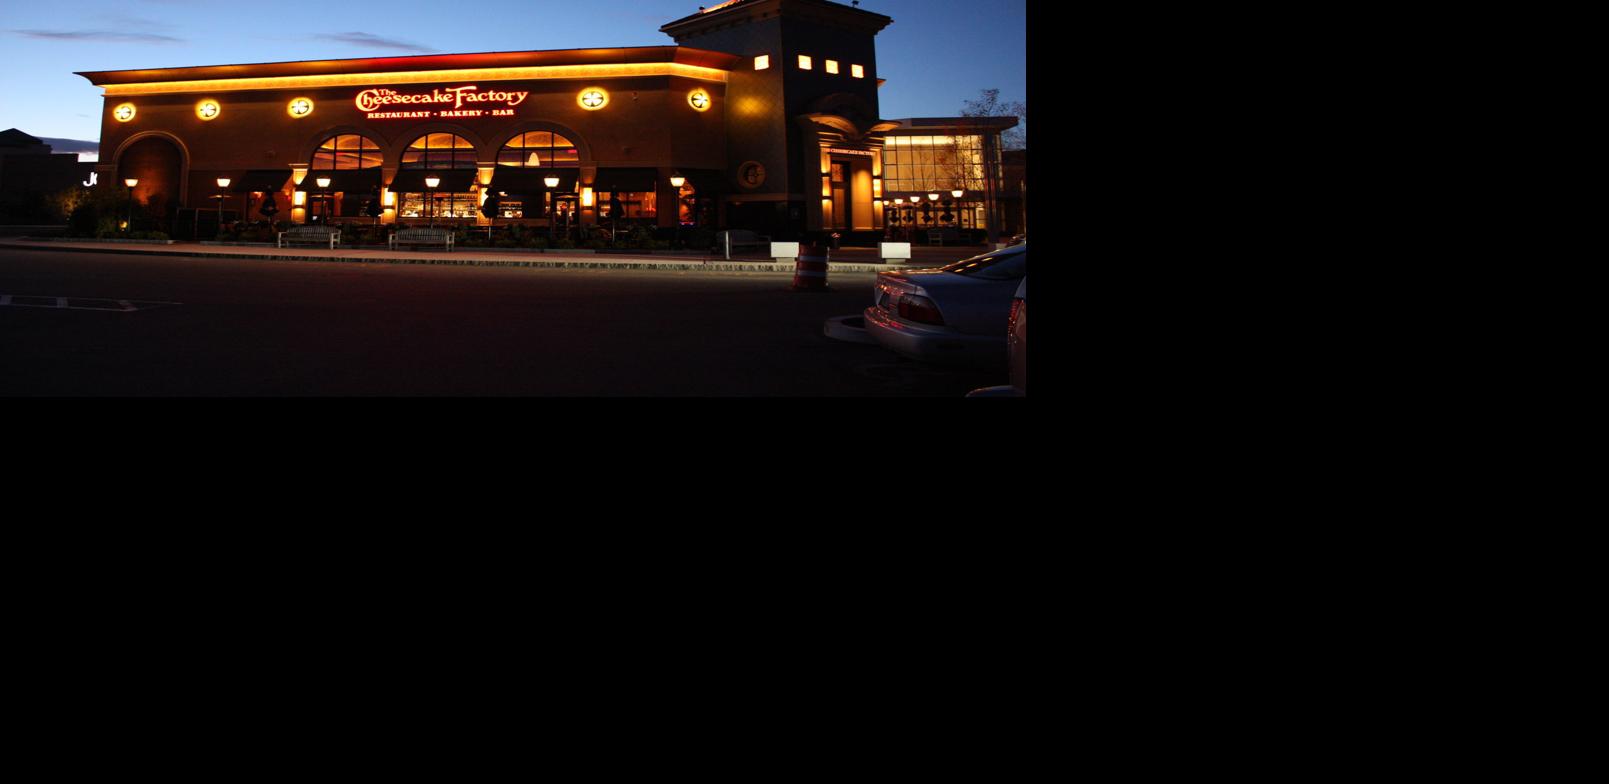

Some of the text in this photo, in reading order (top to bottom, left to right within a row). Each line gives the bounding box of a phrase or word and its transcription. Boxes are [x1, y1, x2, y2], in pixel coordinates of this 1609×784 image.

[379, 88, 397, 96] The
[355, 85, 529, 112] Cheesecake Factory
[367, 111, 431, 119] RESTAURANT
